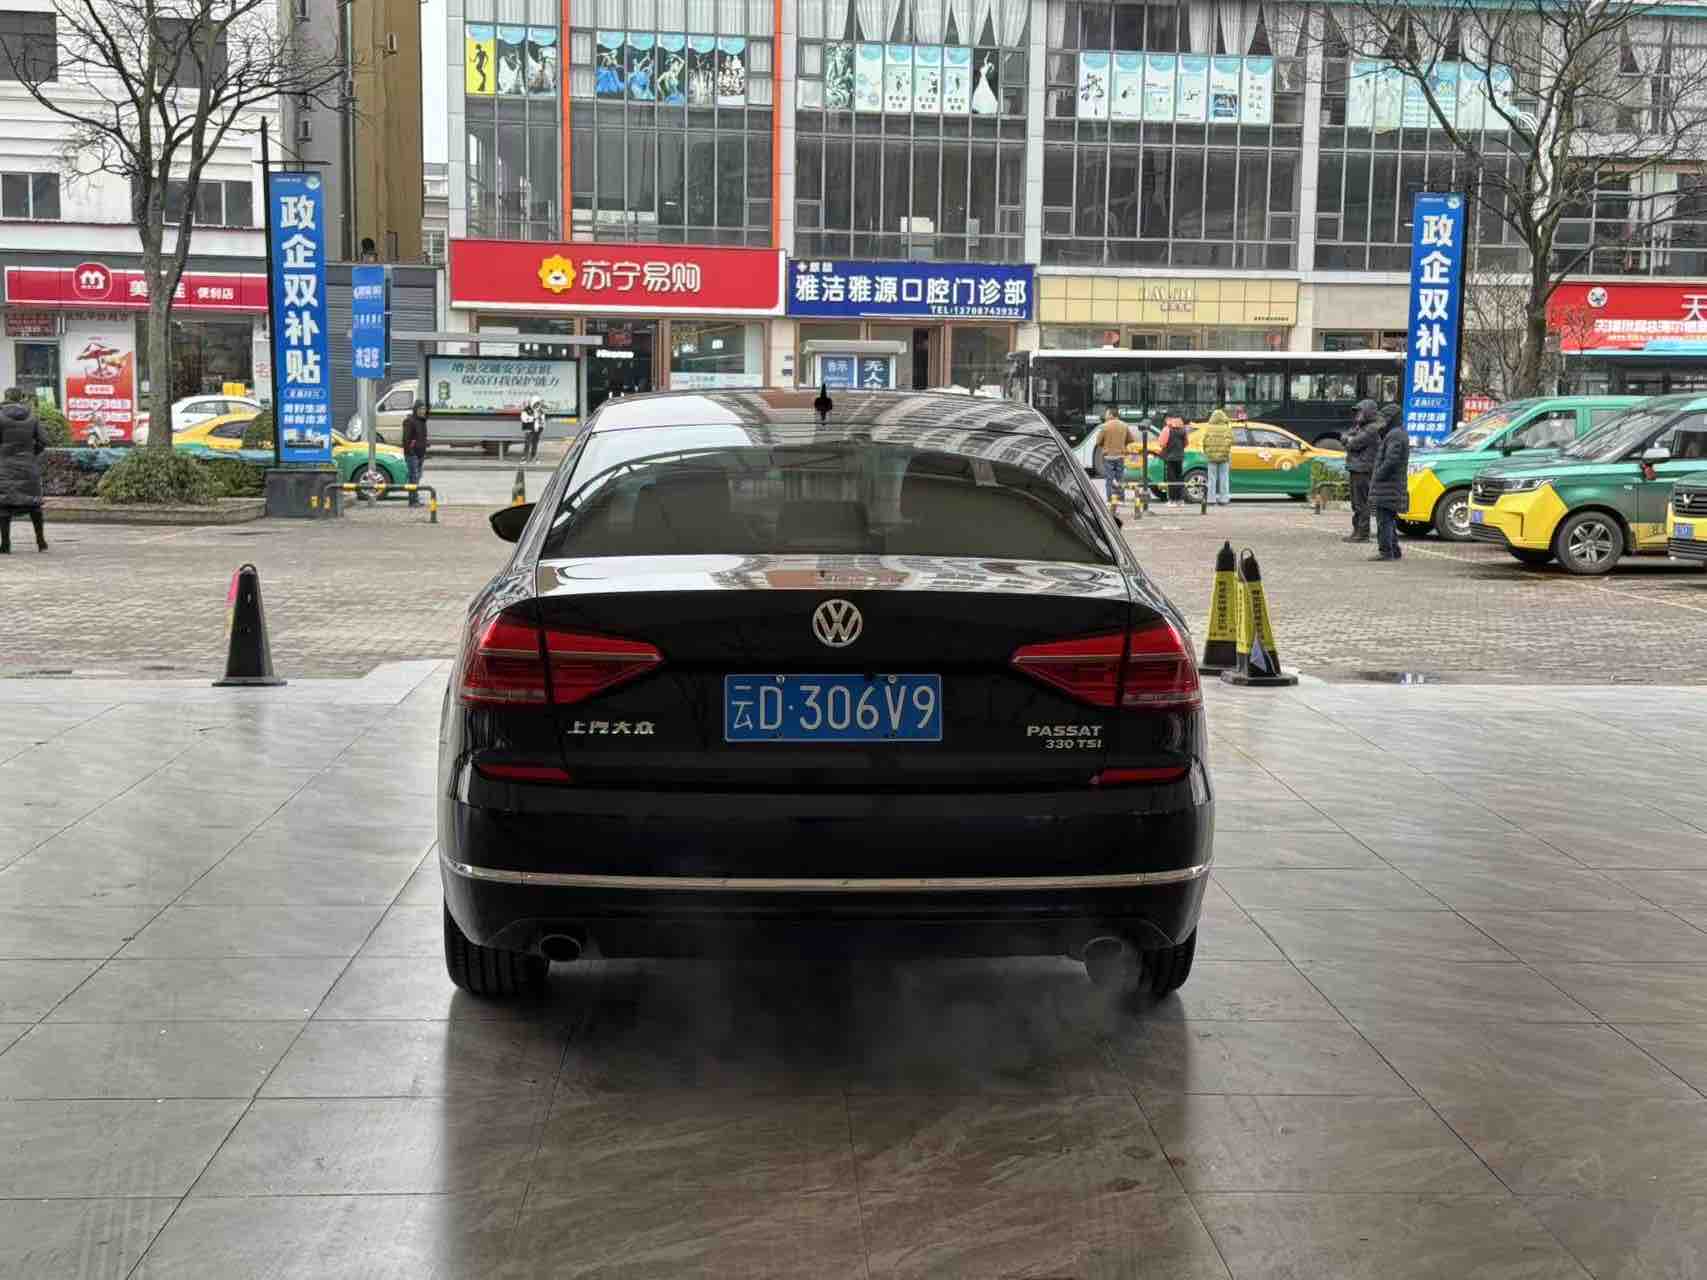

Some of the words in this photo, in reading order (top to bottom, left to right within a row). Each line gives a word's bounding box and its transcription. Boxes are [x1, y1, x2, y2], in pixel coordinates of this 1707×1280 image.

[279, 195, 321, 384] 政企双补贴
[581, 260, 701, 293] 苏宁易购
[795, 274, 1027, 305] 雅洁雅源口腔门诊部
[1412, 214, 1454, 393] 政企双补贴
[567, 720, 656, 735] 上汽大众
[1027, 725, 1102, 736] PASSAT
[1045, 739, 1075, 749] 330
[1076, 739, 1102, 749] TSI
